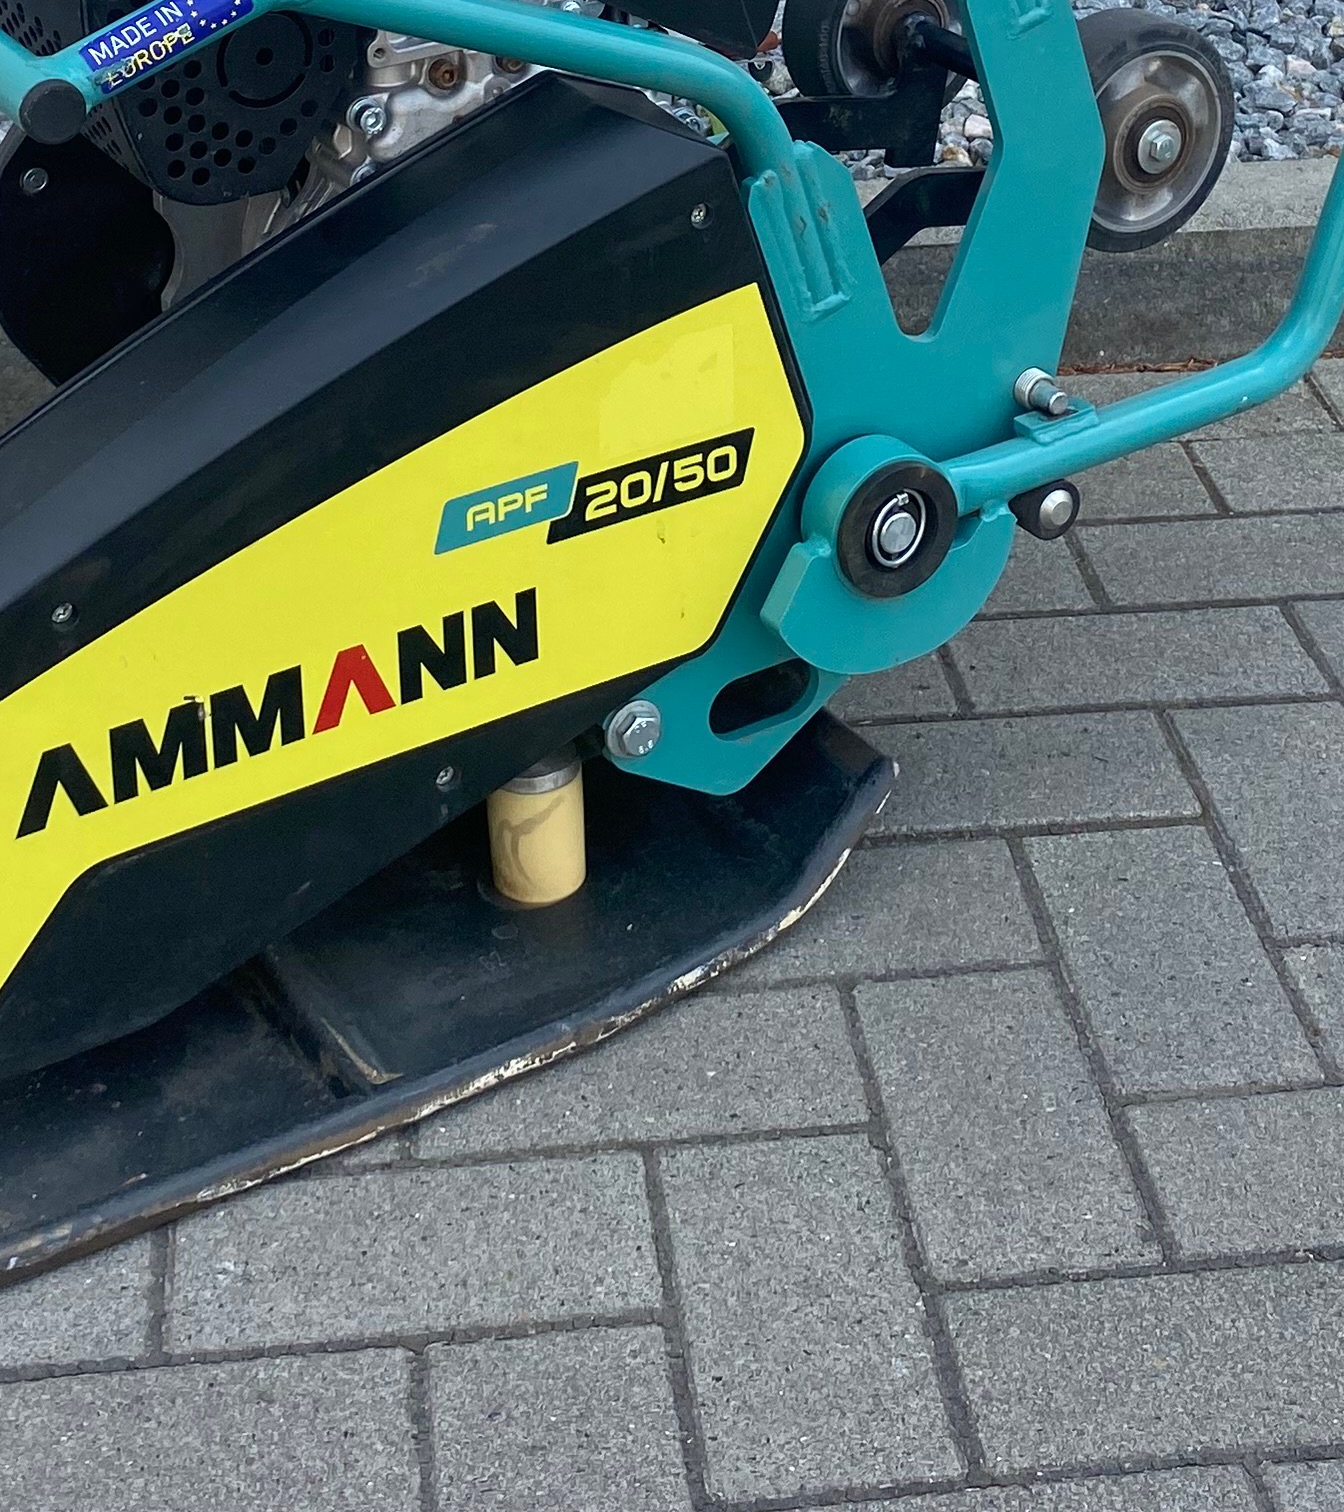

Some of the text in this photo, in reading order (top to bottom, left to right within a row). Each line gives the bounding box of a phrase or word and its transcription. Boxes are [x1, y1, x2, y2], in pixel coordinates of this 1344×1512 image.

[87, 1, 183, 65] MADE IN
[465, 444, 737, 532] APF 20/50
[15, 588, 540, 841] AMMANN
